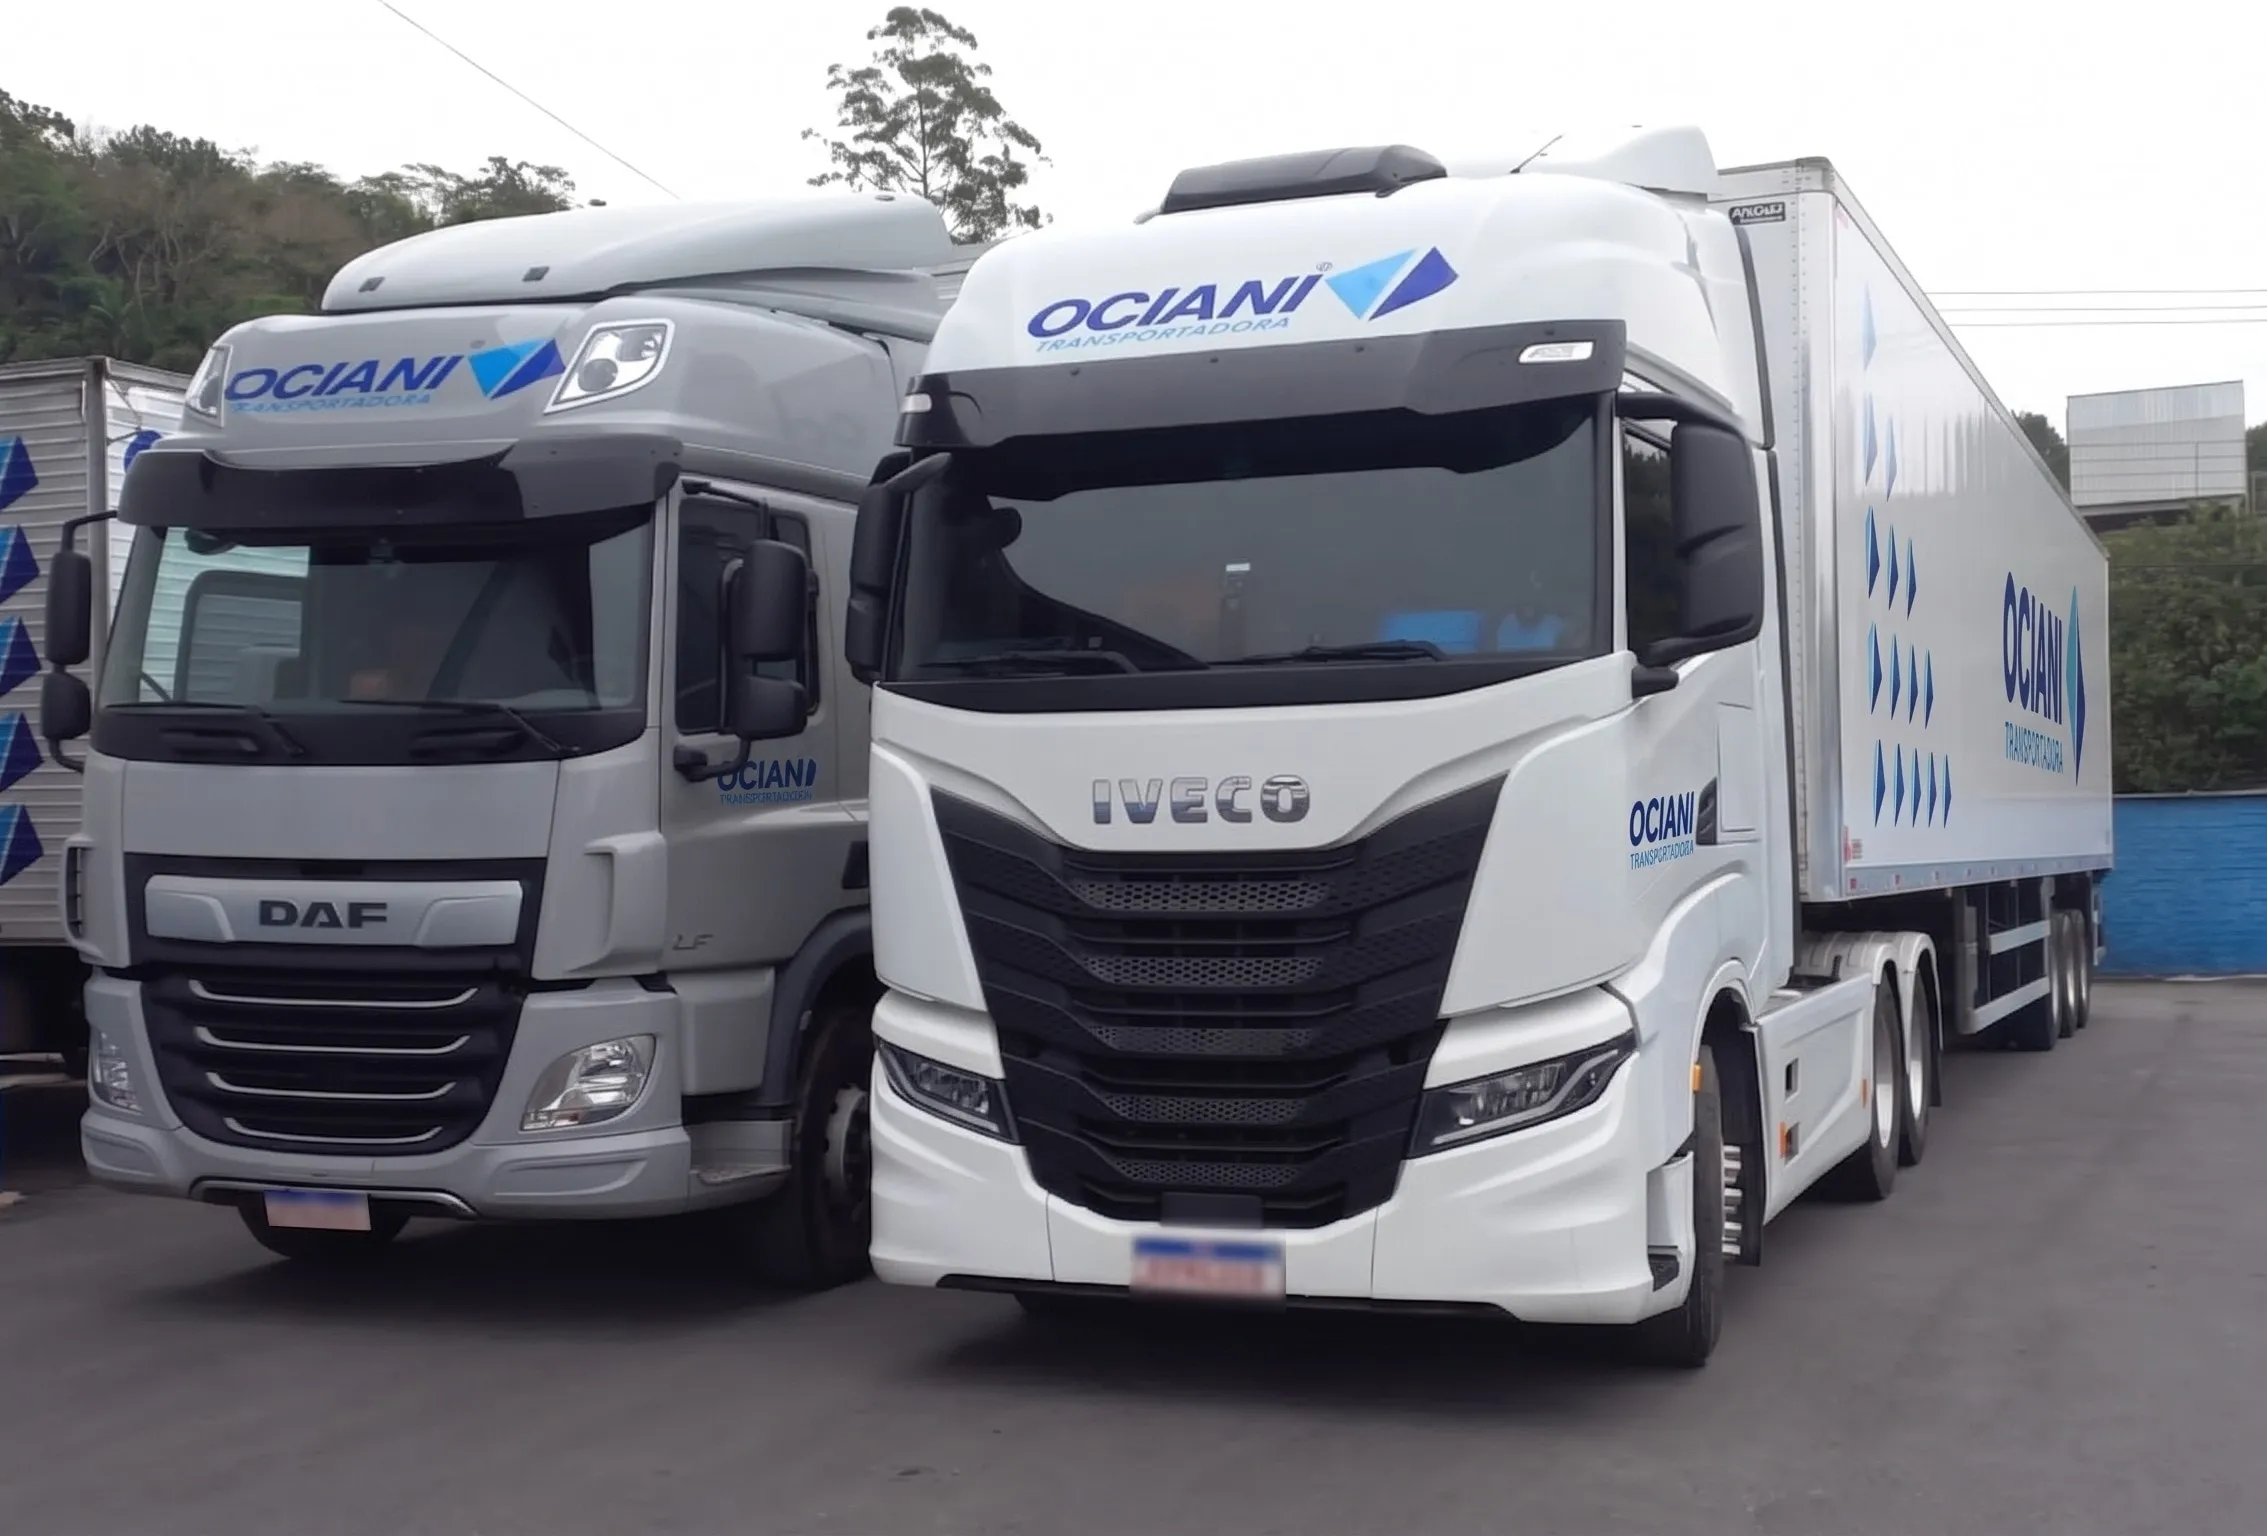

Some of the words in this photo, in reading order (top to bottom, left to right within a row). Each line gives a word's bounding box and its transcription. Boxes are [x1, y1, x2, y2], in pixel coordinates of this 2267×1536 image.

[1027, 273, 1324, 339] OCIANI
[1036, 316, 1291, 353] TRANSPORTADORA
[224, 354, 466, 401] OCIANI
[230, 393, 431, 414] TRANSPORTADORA
[2003, 571, 2062, 725] OCIANI
[1092, 774, 1310, 824] IVECO
[1629, 790, 1694, 847] OCIANI
[259, 900, 388, 929] DAF
